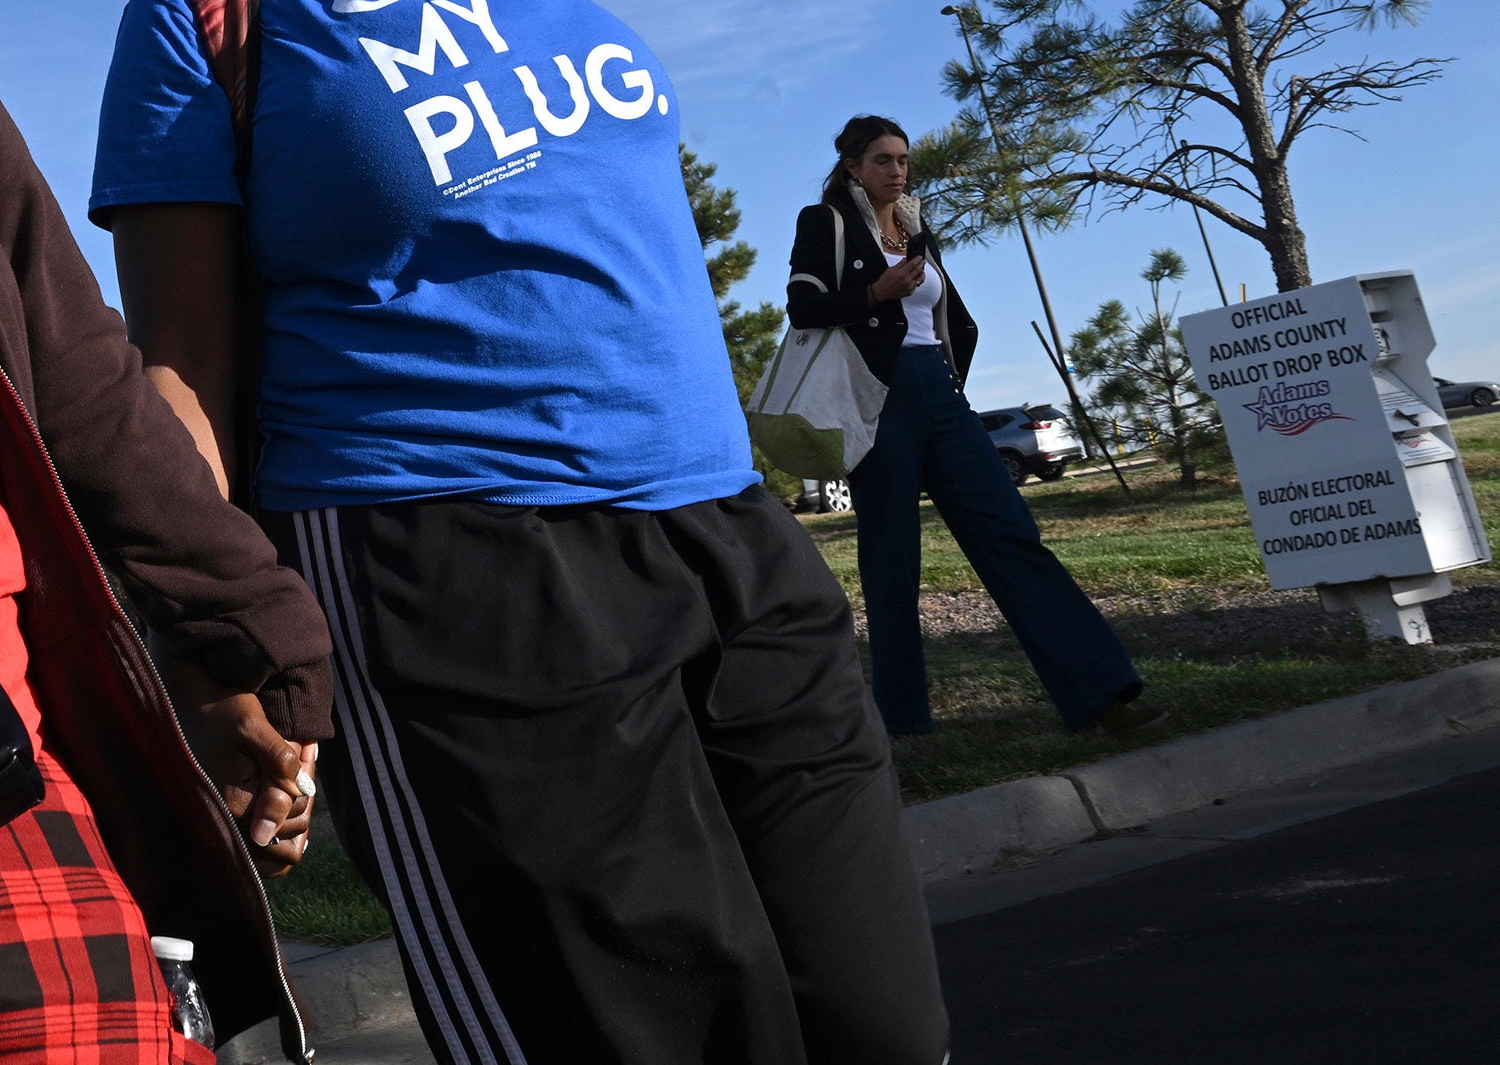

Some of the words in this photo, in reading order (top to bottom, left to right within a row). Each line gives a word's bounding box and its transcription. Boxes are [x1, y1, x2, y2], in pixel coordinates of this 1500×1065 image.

[403, 43, 669, 186] PLUG.
[455, 182, 483, 199] Another
[483, 176, 498, 187] Bad
[498, 166, 525, 180] Creation
[467, 165, 507, 185] Enterprises
[507, 157, 525, 169] Since
[1231, 298, 1308, 329] OFFICIAL
[1209, 333, 1272, 363] ADAMS
[1275, 317, 1348, 349] COUNTY
[1207, 363, 1269, 391] BALLOT
[1273, 353, 1323, 378] DROP
[1328, 344, 1368, 369] BOX
[1258, 380, 1330, 404] Adams
[1272, 403, 1333, 425] Votes
[1258, 481, 1310, 506] BUZÓN
[1312, 469, 1395, 497] ELECTORAL
[1289, 503, 1346, 526] OFICIAL
[1348, 498, 1377, 517] DEL
[1263, 529, 1338, 556] CONDADO
[1342, 525, 1362, 543] DE
[1364, 517, 1422, 541] ADAMS
